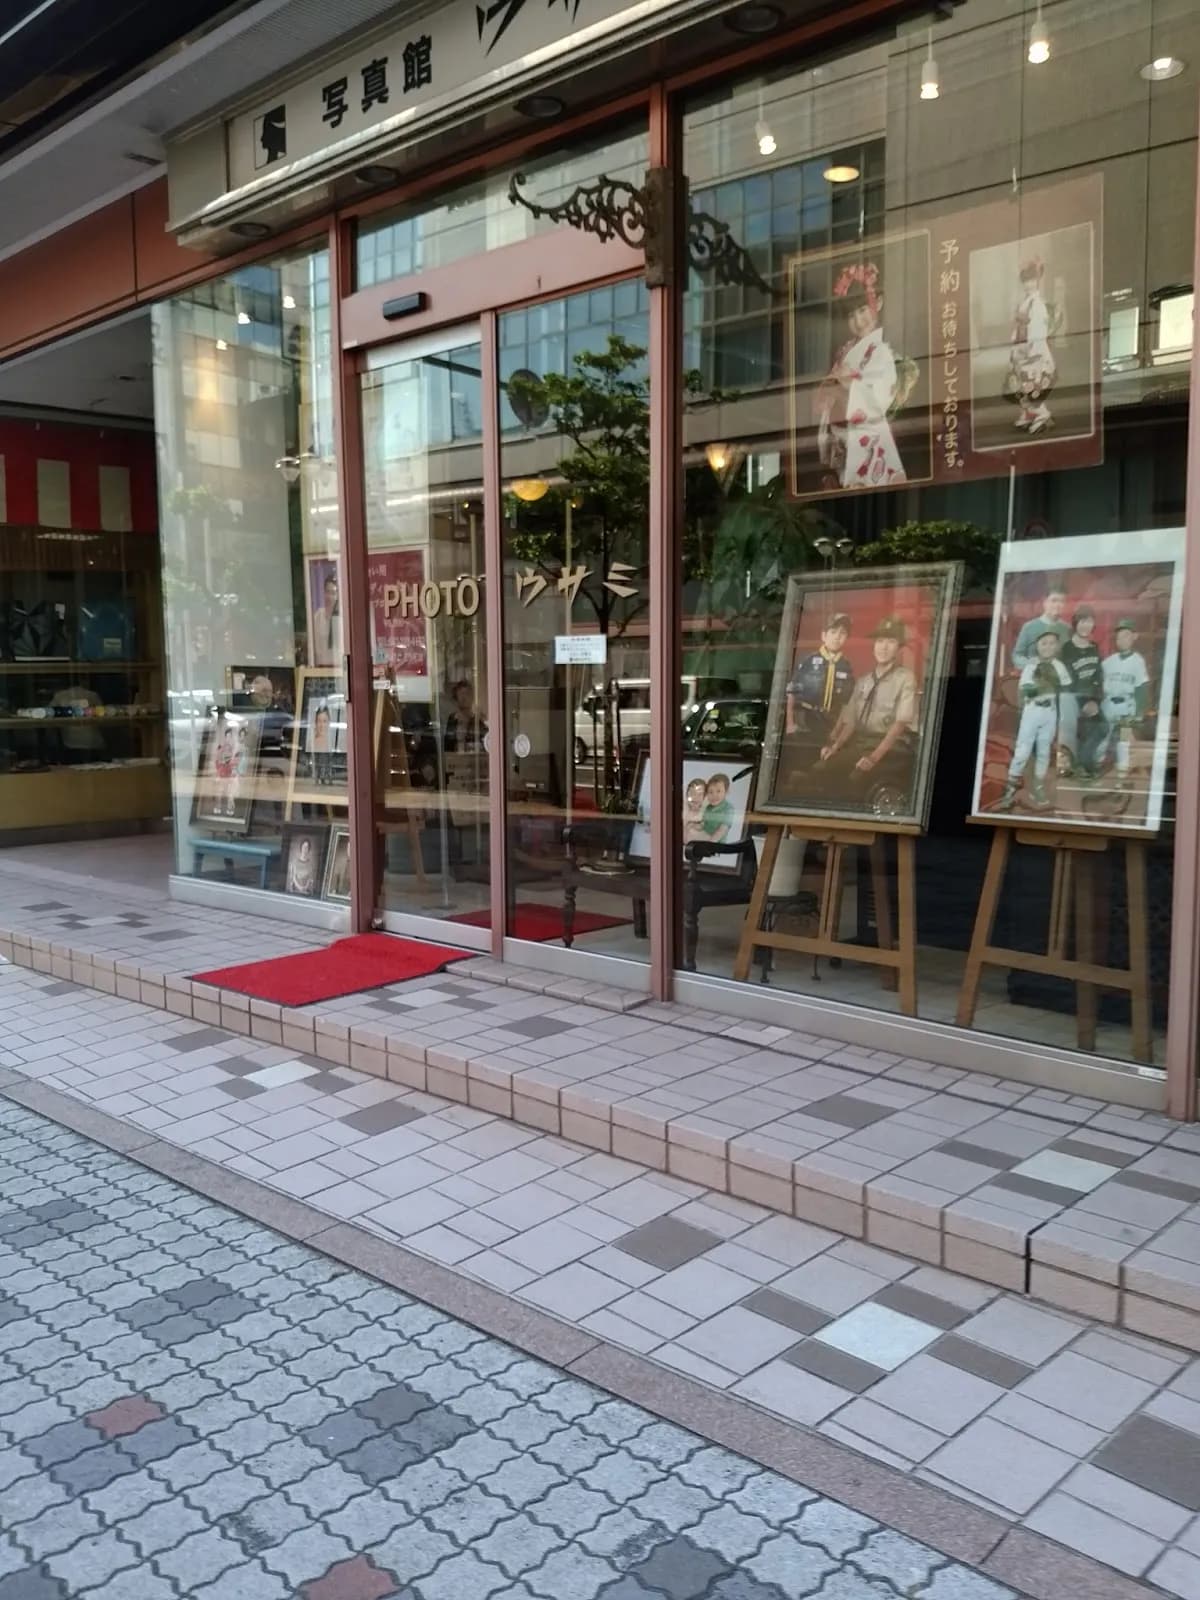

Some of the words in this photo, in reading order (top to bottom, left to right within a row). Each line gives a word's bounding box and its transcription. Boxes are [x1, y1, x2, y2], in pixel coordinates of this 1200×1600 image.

[322, 35, 433, 128] 写真館
[384, 578, 480, 618] PHOTO
[516, 562, 639, 607] ウサミ
